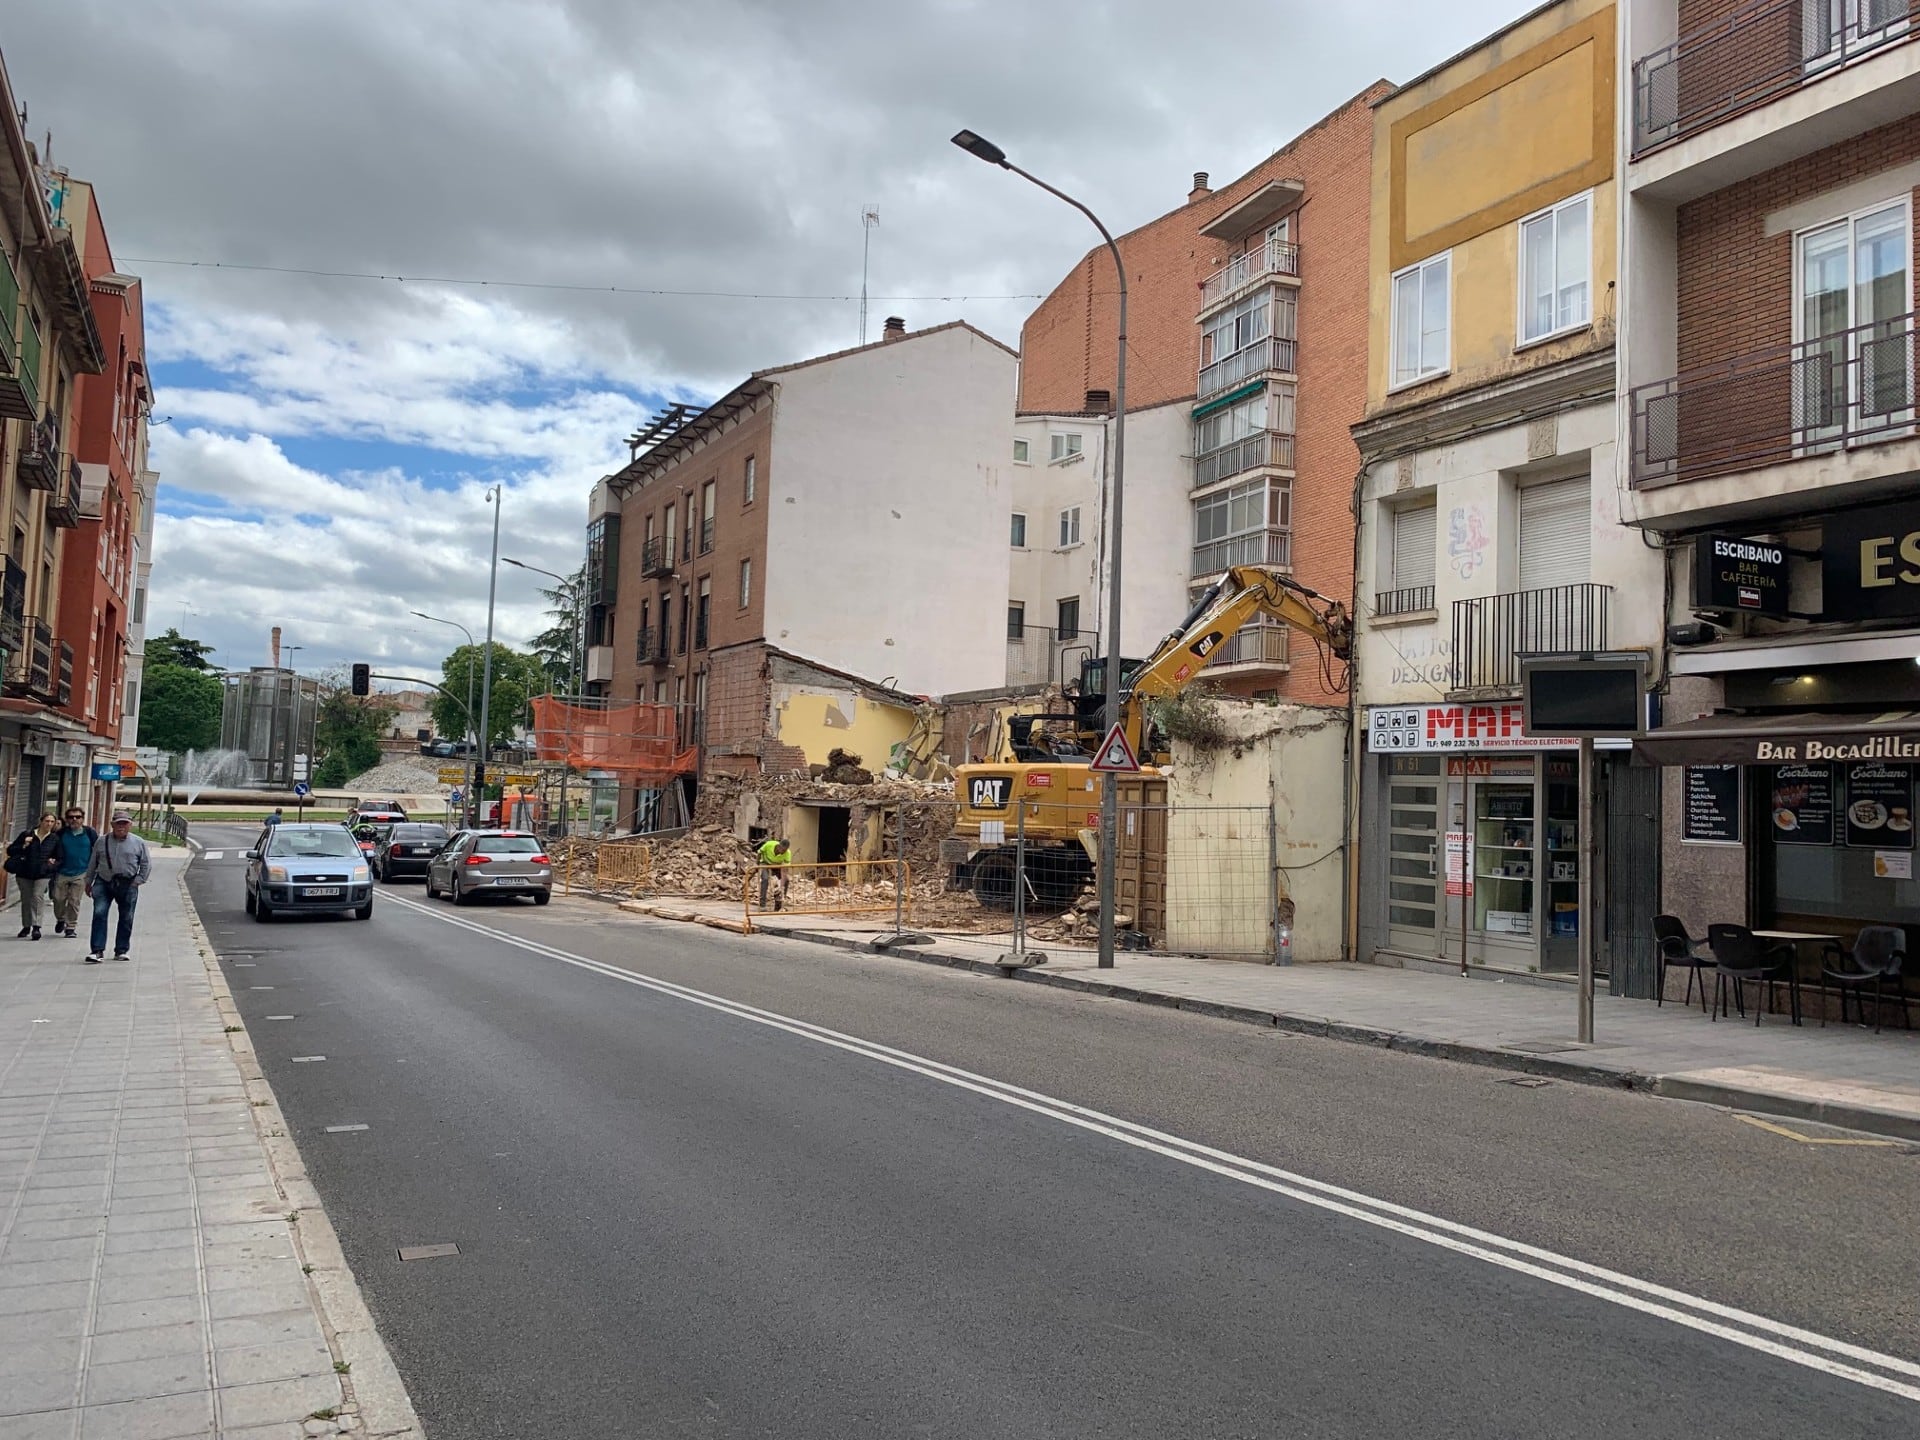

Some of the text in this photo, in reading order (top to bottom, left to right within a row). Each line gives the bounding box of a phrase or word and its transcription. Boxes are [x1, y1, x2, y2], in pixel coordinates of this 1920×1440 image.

[1714, 540, 1782, 564] ESCRIBANO
[1738, 562, 1759, 574] BAR
[1721, 571, 1777, 588] CAFETERÍA
[1199, 635, 1213, 655] CAT
[1511, 738, 1537, 746] TÉCNICO
[1777, 765, 1829, 779] Escribano
[1851, 765, 1908, 779] Escribano
[973, 780, 1003, 808] CAT
